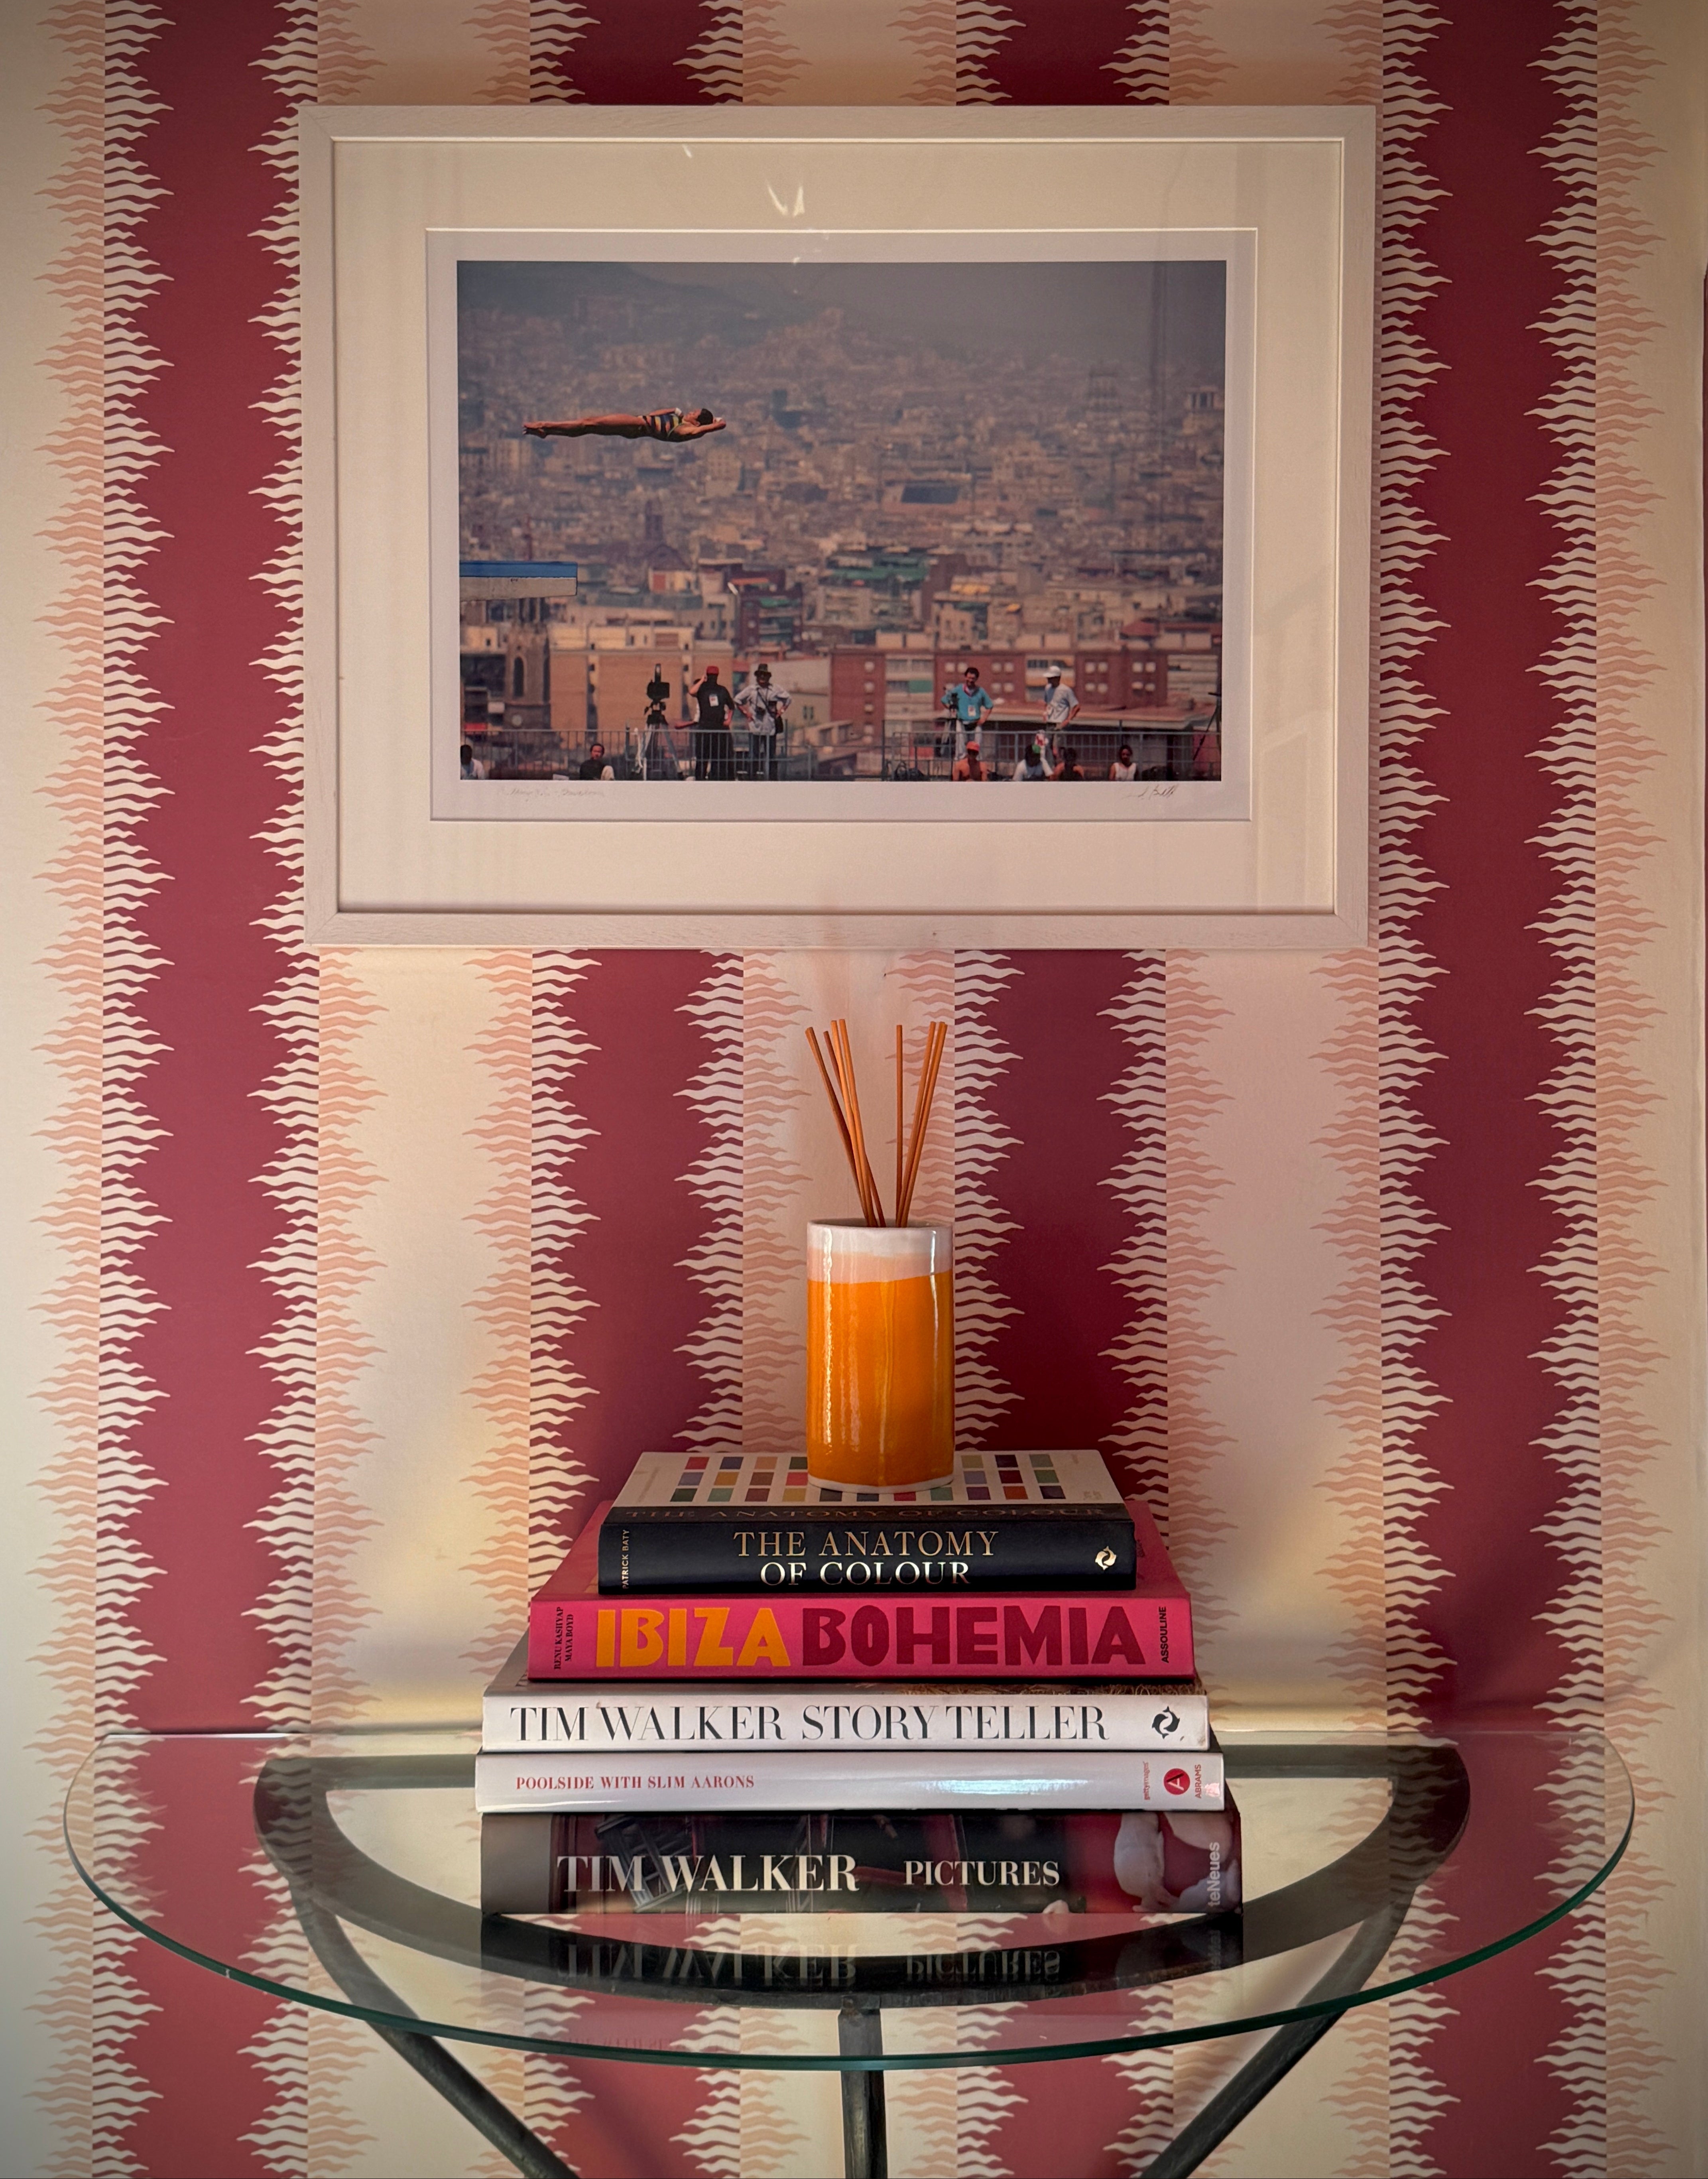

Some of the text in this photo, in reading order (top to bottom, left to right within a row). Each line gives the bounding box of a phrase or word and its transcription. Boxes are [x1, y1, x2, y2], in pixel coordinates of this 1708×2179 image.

[734, 1531, 999, 1556] THE ANATOMY
[761, 1561, 971, 1585] OF COLOUR
[565, 1638, 573, 1662] MAYA
[596, 1605, 1146, 1667] IBIZA BOHEMIA
[1159, 1606, 1169, 1663] ASSOULINE
[510, 1705, 1110, 1741] TIM WALKER STORY TELLER
[516, 1775, 754, 1789] POOLSIDE WITH SLIM AARONS
[557, 1854, 1060, 1892] TIM WALKER PICTURES
[1207, 1842, 1220, 1907] teNeues
